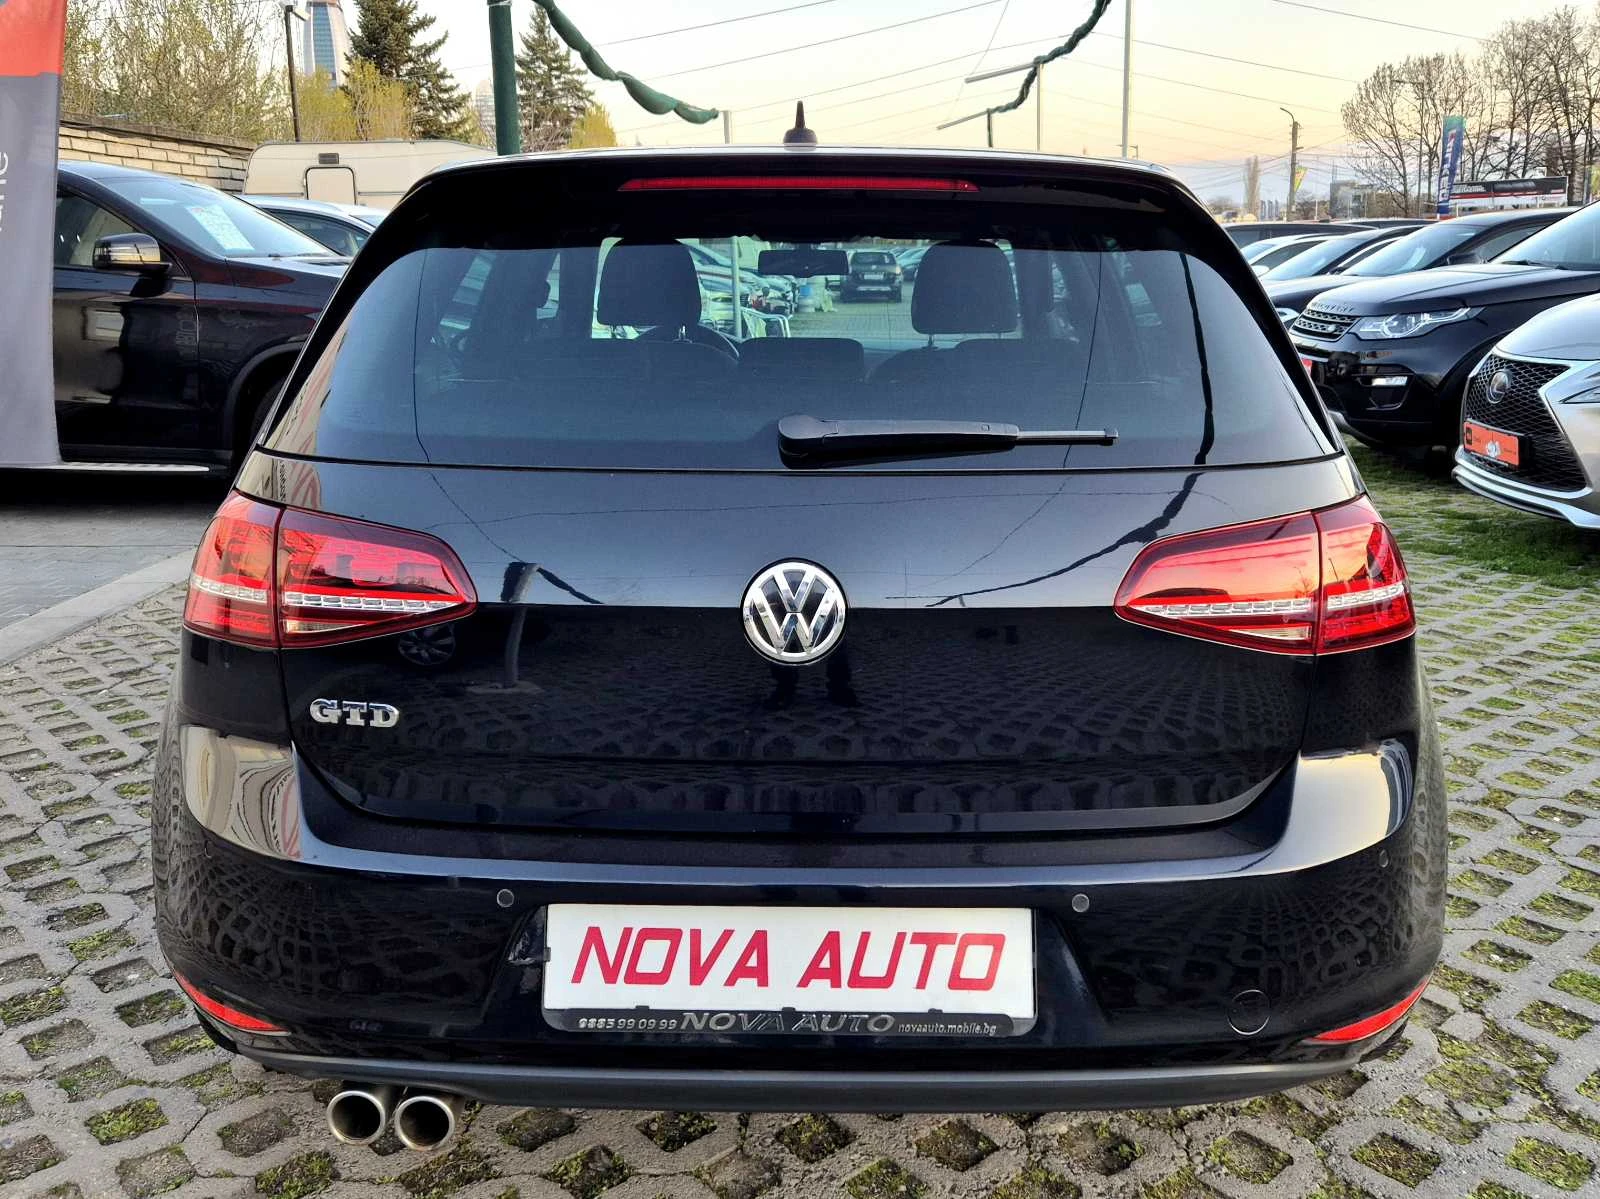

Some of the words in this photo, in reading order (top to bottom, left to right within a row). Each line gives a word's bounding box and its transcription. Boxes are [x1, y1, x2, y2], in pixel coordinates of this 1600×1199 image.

[310, 698, 400, 728] GTD
[571, 926, 769, 988] NOVA
[797, 930, 1007, 991] AUTO
[680, 1012, 786, 1031] NOVA
[791, 1014, 896, 1033] AUTO
[898, 1022, 997, 1036] novaauto.mobile.bg
